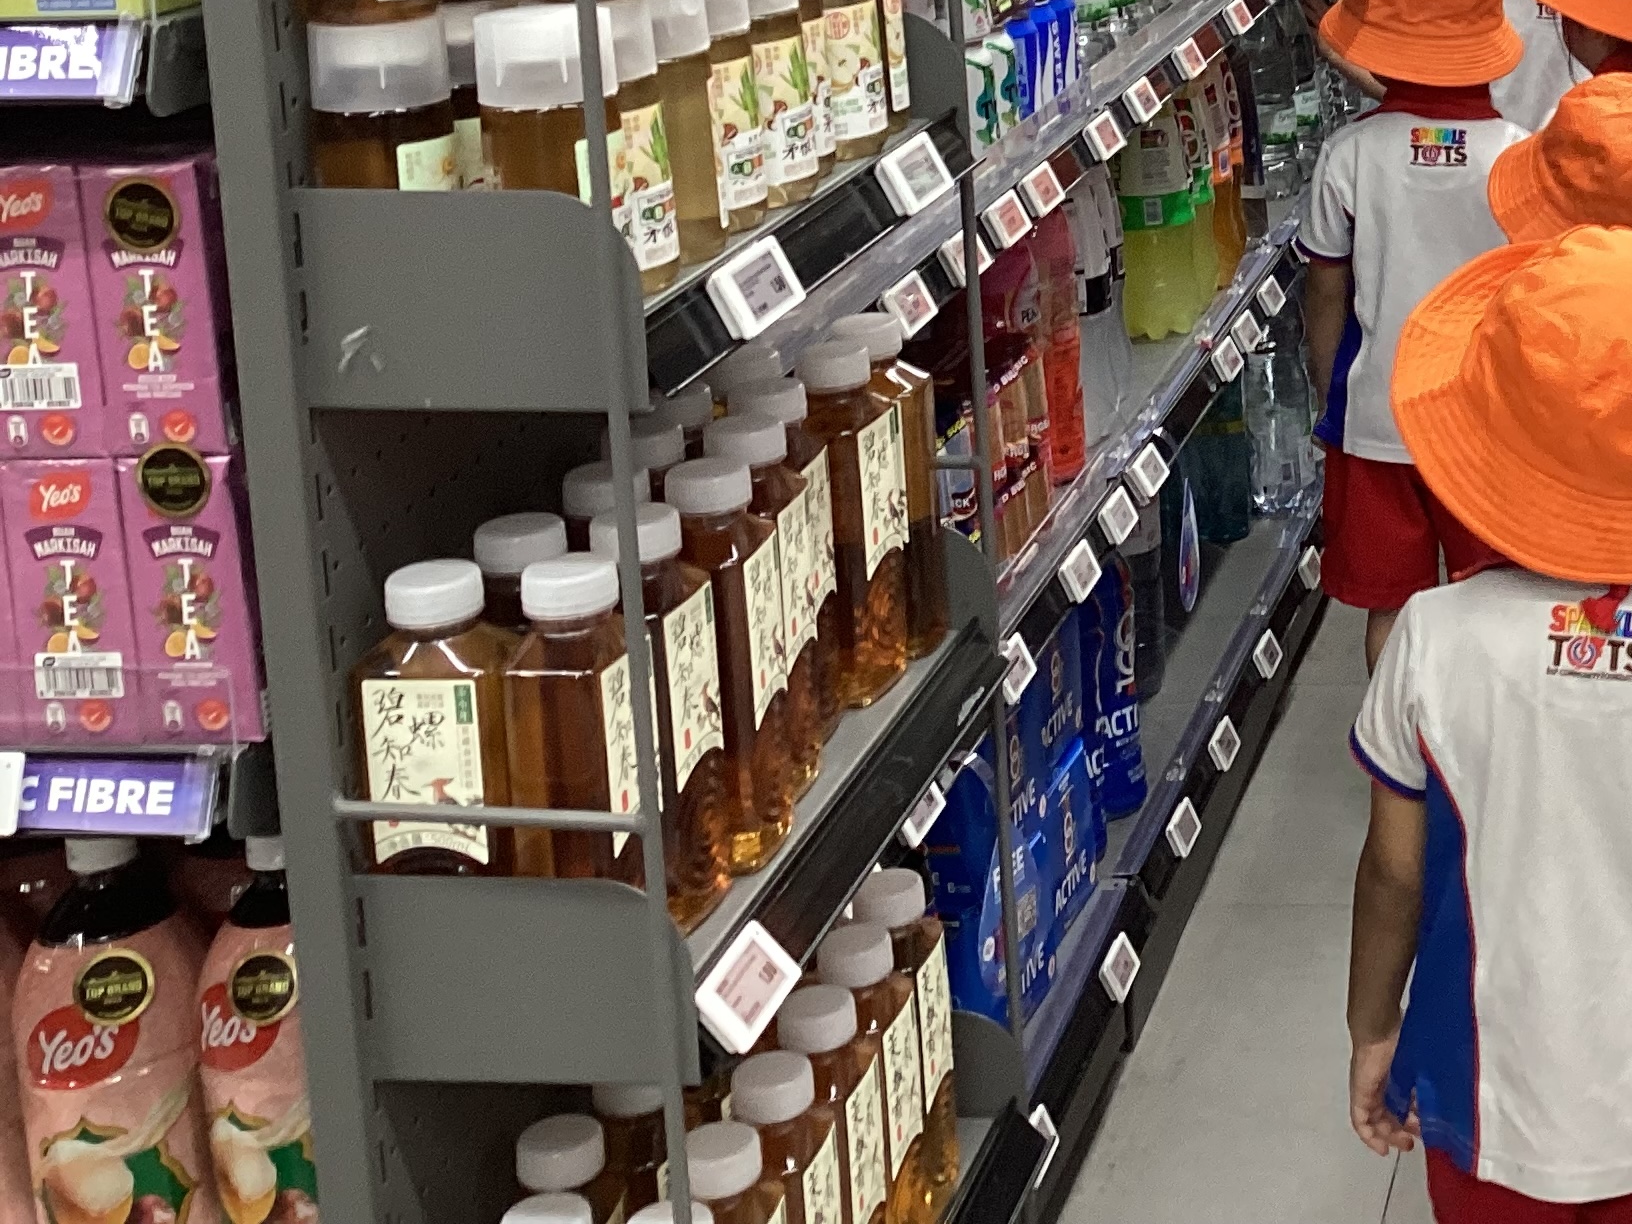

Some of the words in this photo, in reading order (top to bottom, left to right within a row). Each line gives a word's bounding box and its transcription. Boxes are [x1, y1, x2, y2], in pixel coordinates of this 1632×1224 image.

[1410, 144, 1468, 164] TOTS
[39, 483, 82, 513] Yeo's
[34, 537, 96, 558] MARKISAH
[152, 535, 213, 558] MARKISAH
[47, 776, 175, 816] FIBRE
[38, 1024, 119, 1075] Yeo's
